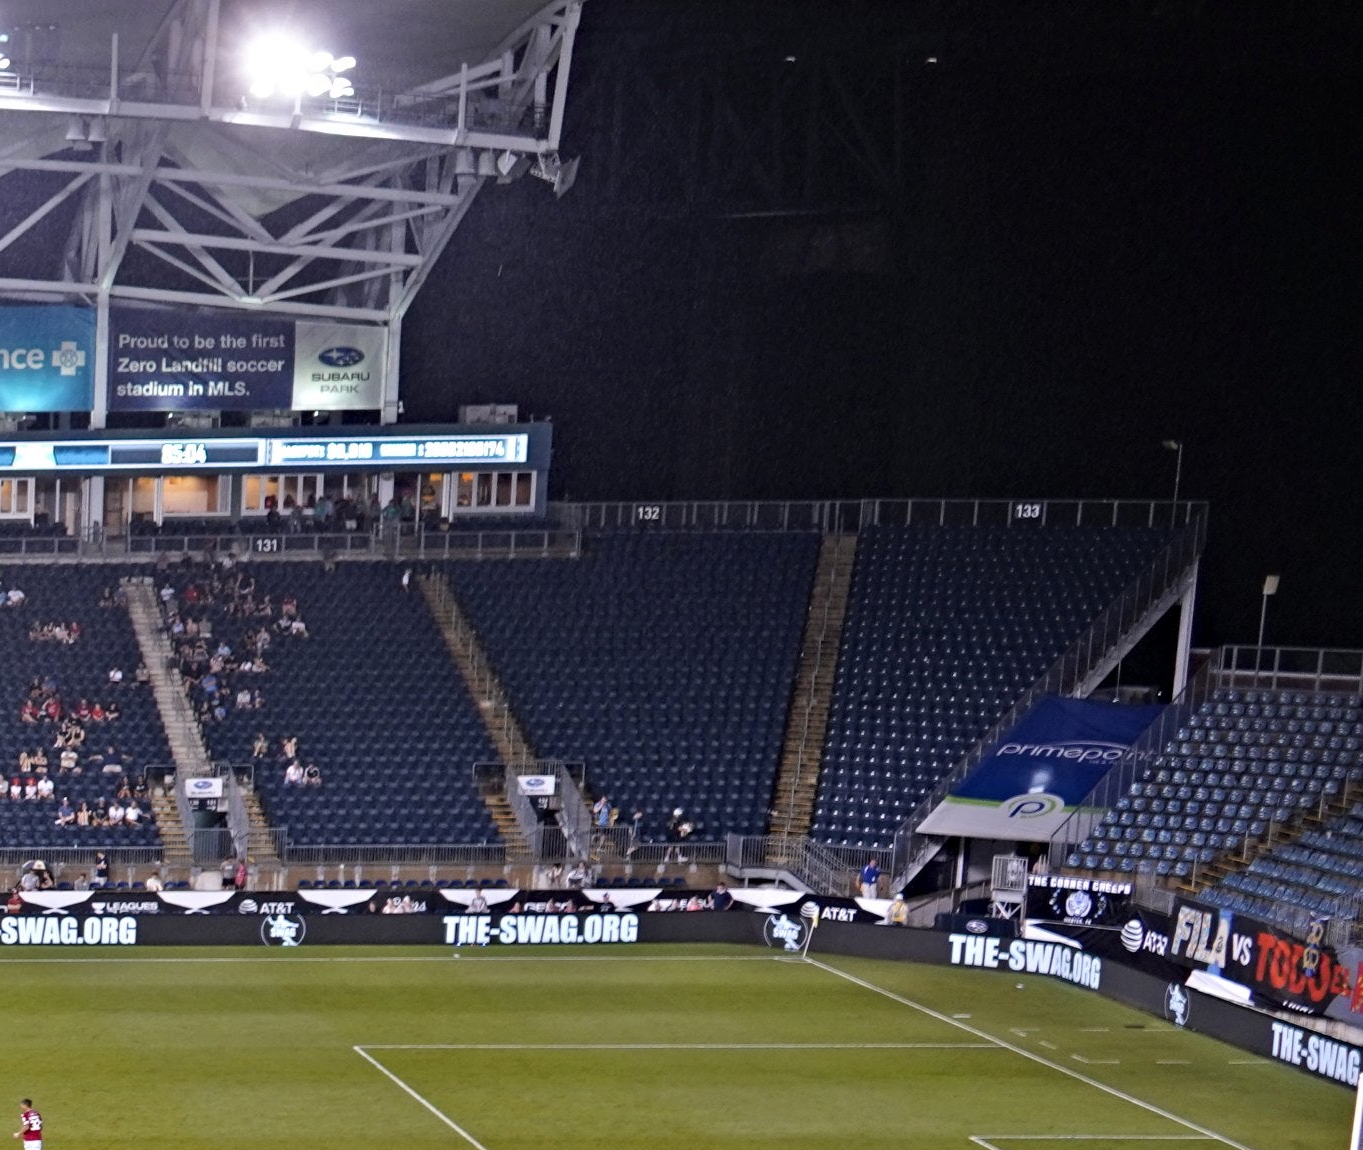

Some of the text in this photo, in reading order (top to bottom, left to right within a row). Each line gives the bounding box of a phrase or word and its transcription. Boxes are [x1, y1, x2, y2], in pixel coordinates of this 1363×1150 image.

[119, 333, 286, 349] Proud to be the first
[117, 357, 285, 373] Zero Landfill soccer
[311, 372, 370, 382] SUBARU
[117, 381, 250, 397] stadium in MLS.
[319, 385, 360, 394] PARK
[637, 505, 660, 520] 132
[1016, 504, 1041, 518] 133
[256, 539, 278, 552] 131
[996, 742, 1156, 763] primepont
[1028, 876, 1132, 895] THE CORNER CREEPS
[106, 901, 159, 911] LEAGUES
[259, 902, 295, 914] AT&T
[821, 906, 857, 922] AT&T
[443, 914, 638, 944] THE-SWAG.ORG
[1232, 932, 1253, 966] VS
[949, 934, 1102, 990] THE-SWAG.ORG
